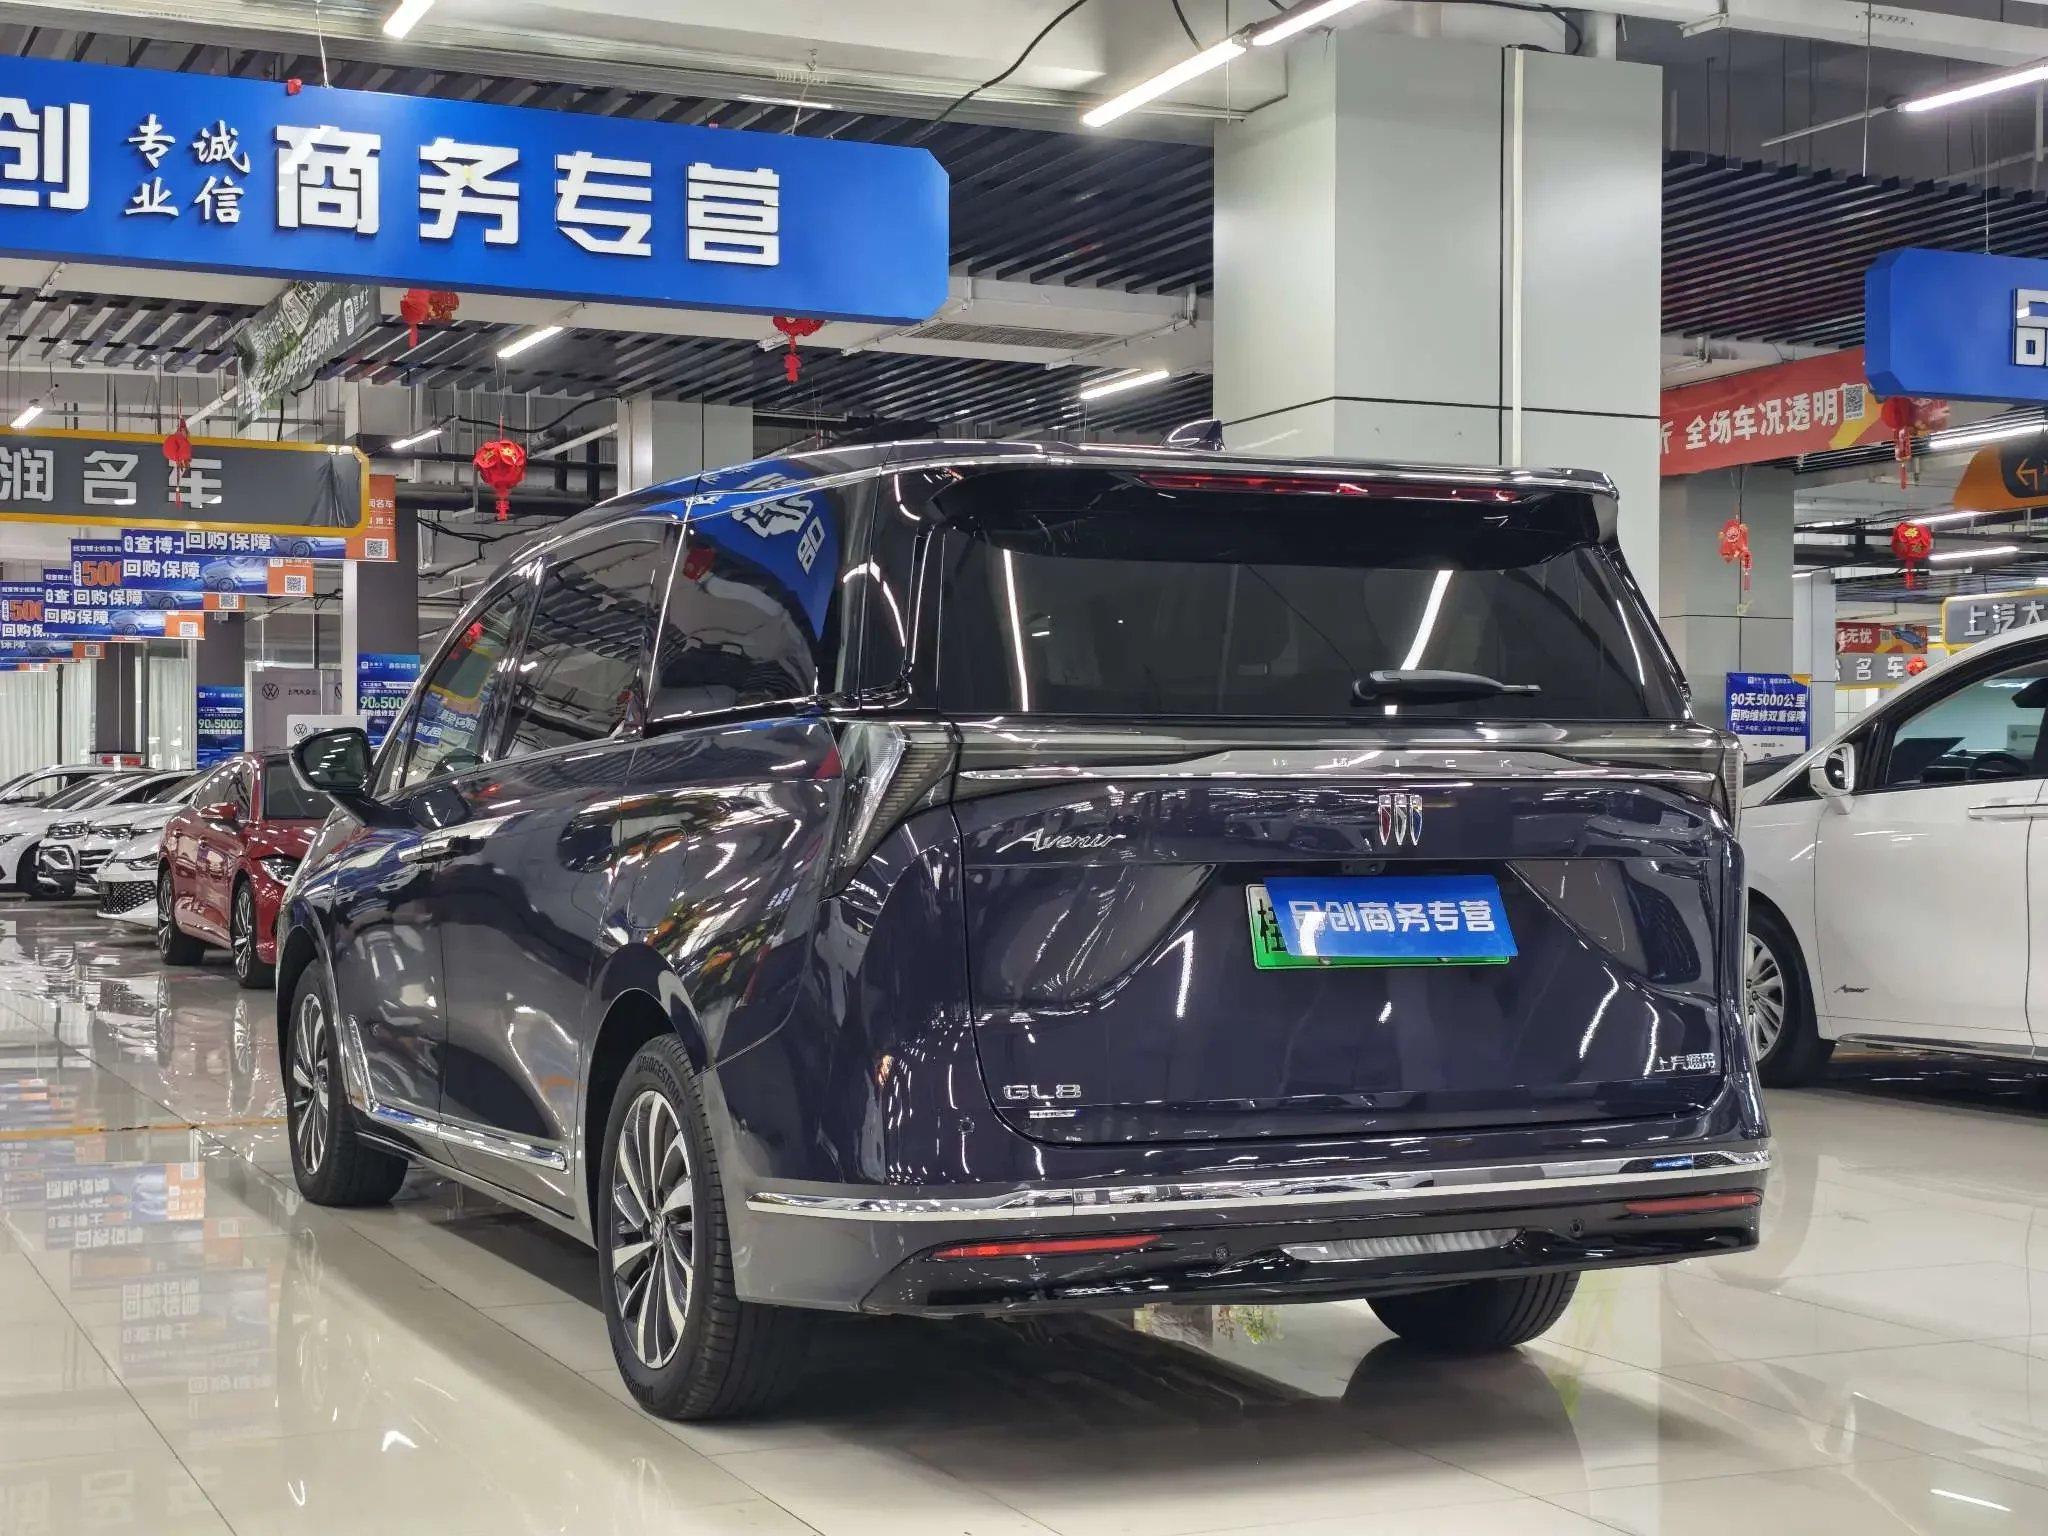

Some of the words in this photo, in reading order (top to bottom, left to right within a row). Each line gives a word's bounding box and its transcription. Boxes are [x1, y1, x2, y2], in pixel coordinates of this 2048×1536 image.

[275, 124, 782, 267] 商务专营
[1686, 387, 1838, 450] 全场车况透明
[0, 446, 222, 508] 润名车
[185, 530, 272, 551] 回购保障
[123, 558, 200, 580] 回购保障
[73, 588, 143, 606] 回购保障
[44, 608, 109, 624] 回购保障
[1731, 693, 1806, 708] 90天5000公里
[995, 827, 1127, 854] Avenir
[1003, 1084, 1082, 1100] GL8
